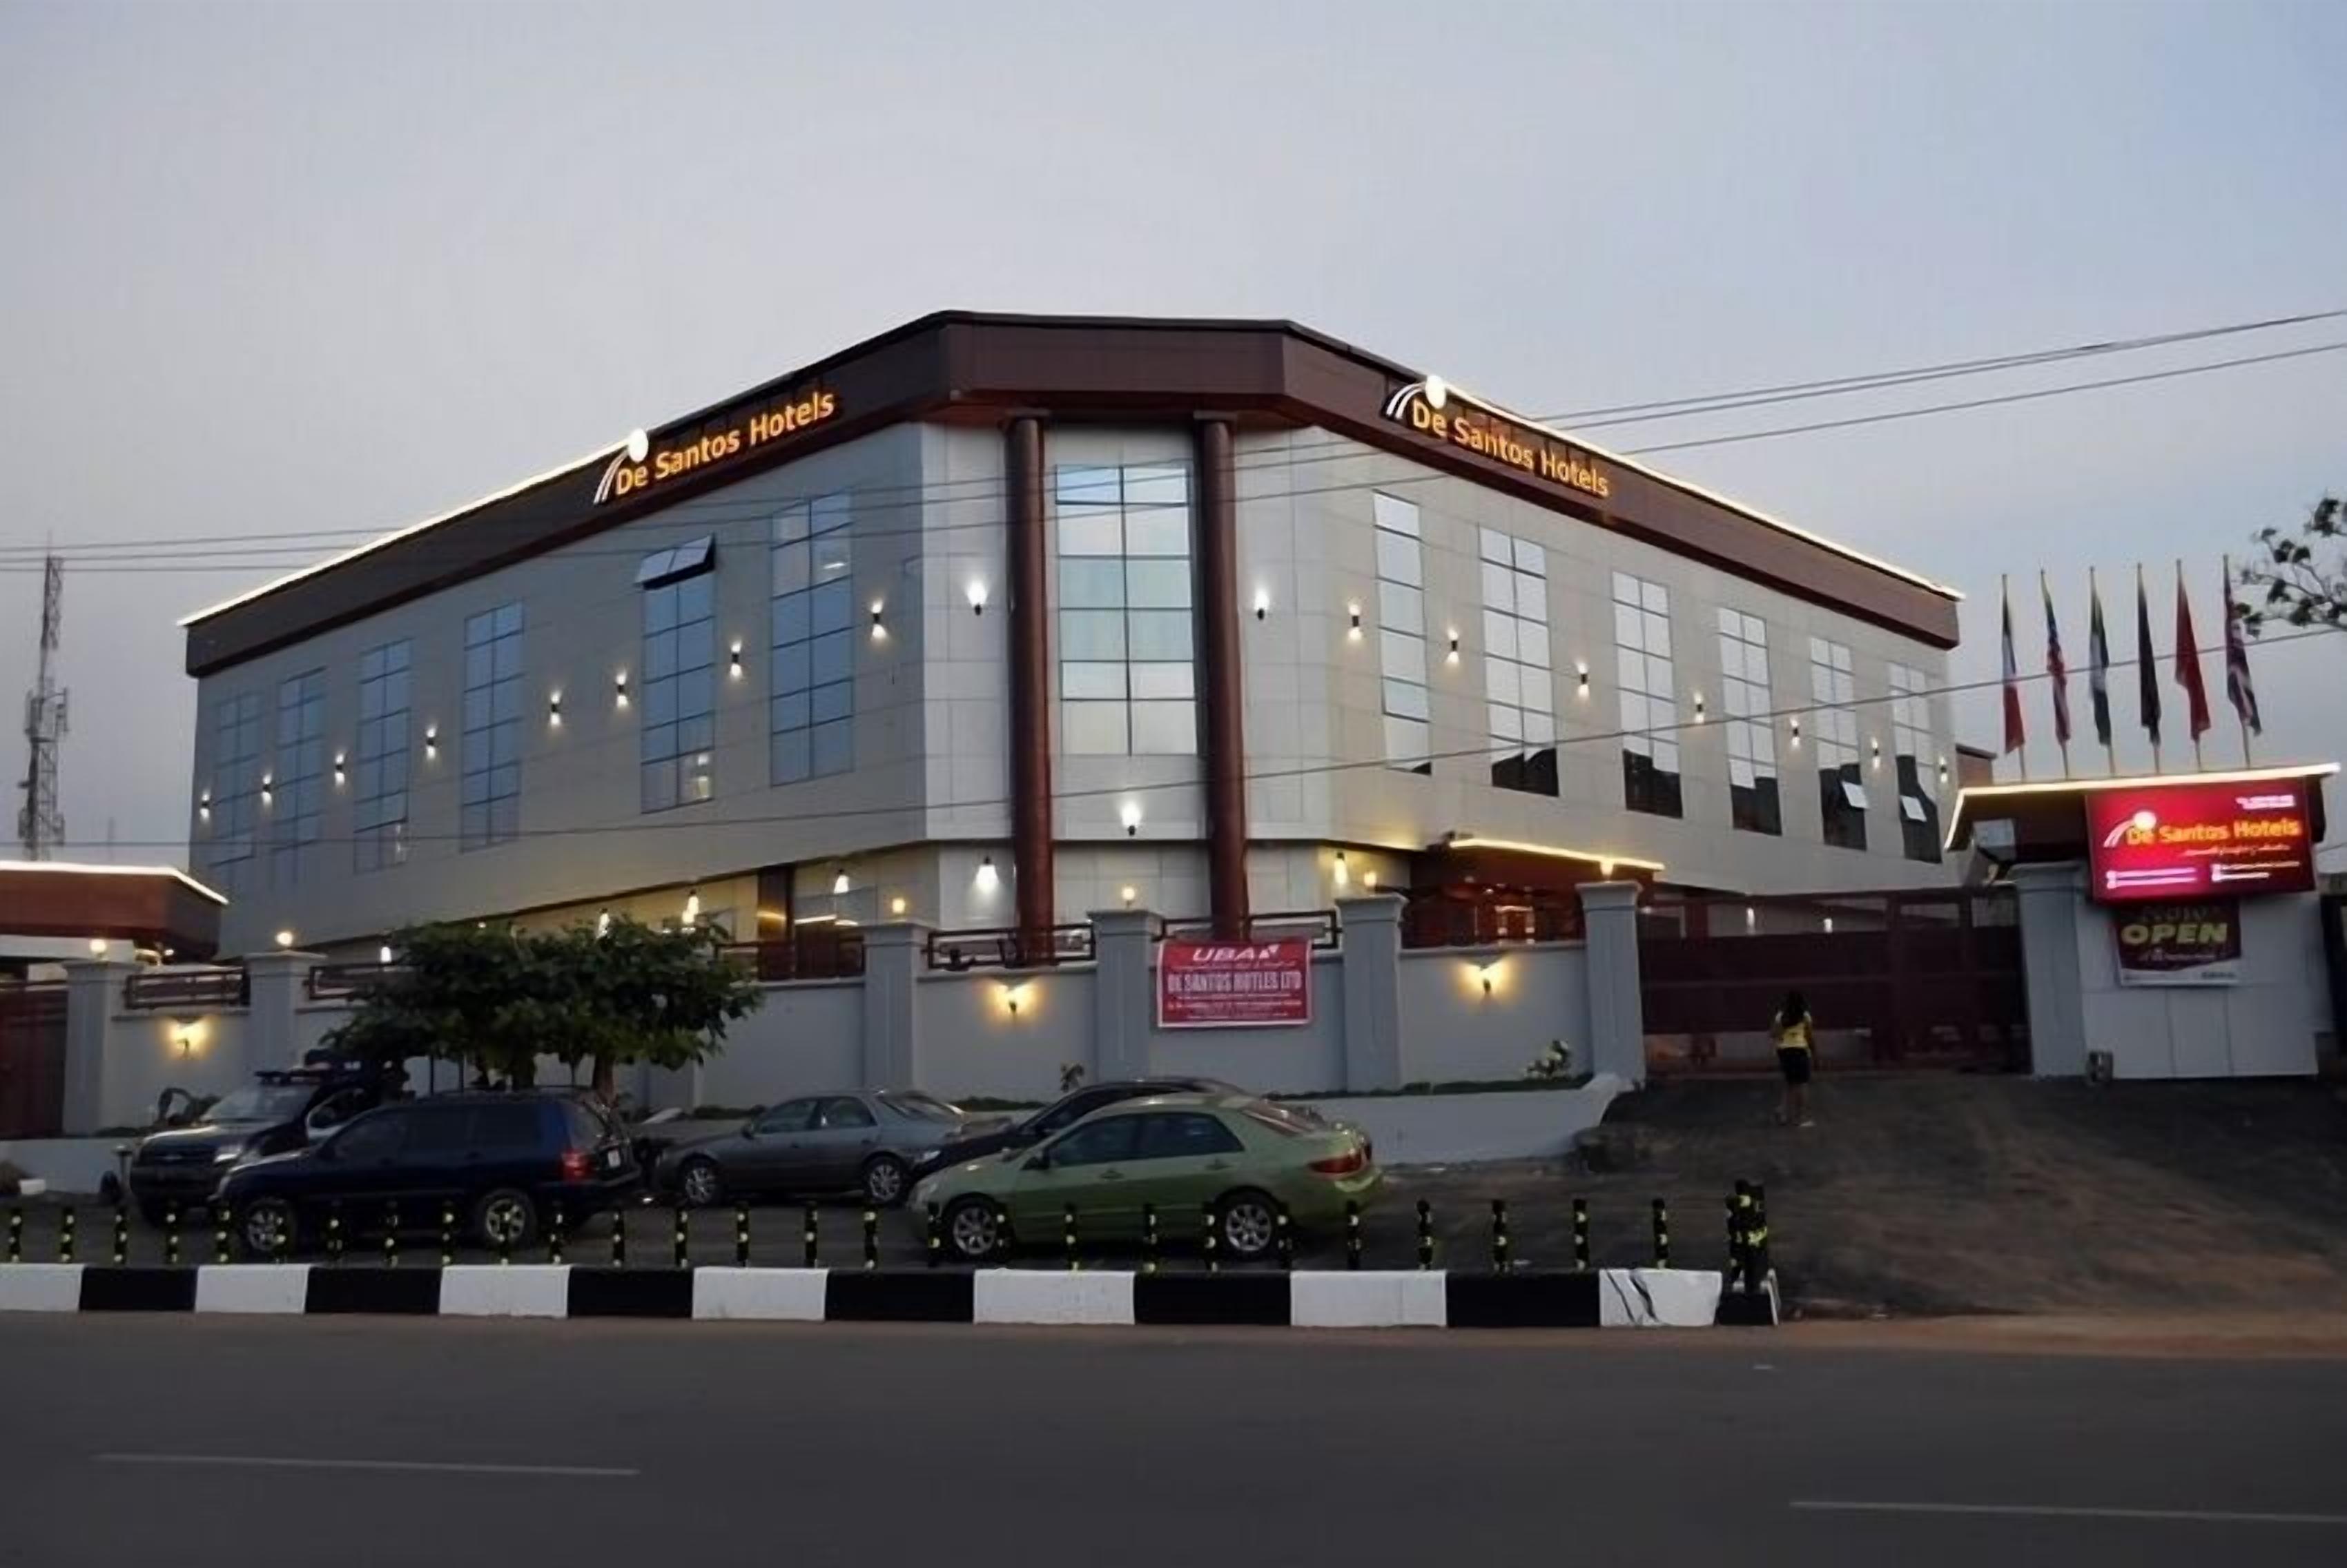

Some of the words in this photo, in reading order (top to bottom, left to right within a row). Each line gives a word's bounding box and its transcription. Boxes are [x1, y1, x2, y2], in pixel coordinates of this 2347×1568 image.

[614, 467, 649, 496] De
[654, 429, 741, 480] Santos
[750, 391, 835, 445] Hotels
[1412, 400, 1447, 437] De
[1454, 417, 1534, 469] Santos
[1541, 447, 1609, 498] Hotels
[2126, 826, 2155, 845] De
[2159, 824, 2230, 843] Santos
[2234, 817, 2302, 838] Hotels
[2121, 923, 2228, 945] OPEN
[1193, 946, 1254, 961] UBA
